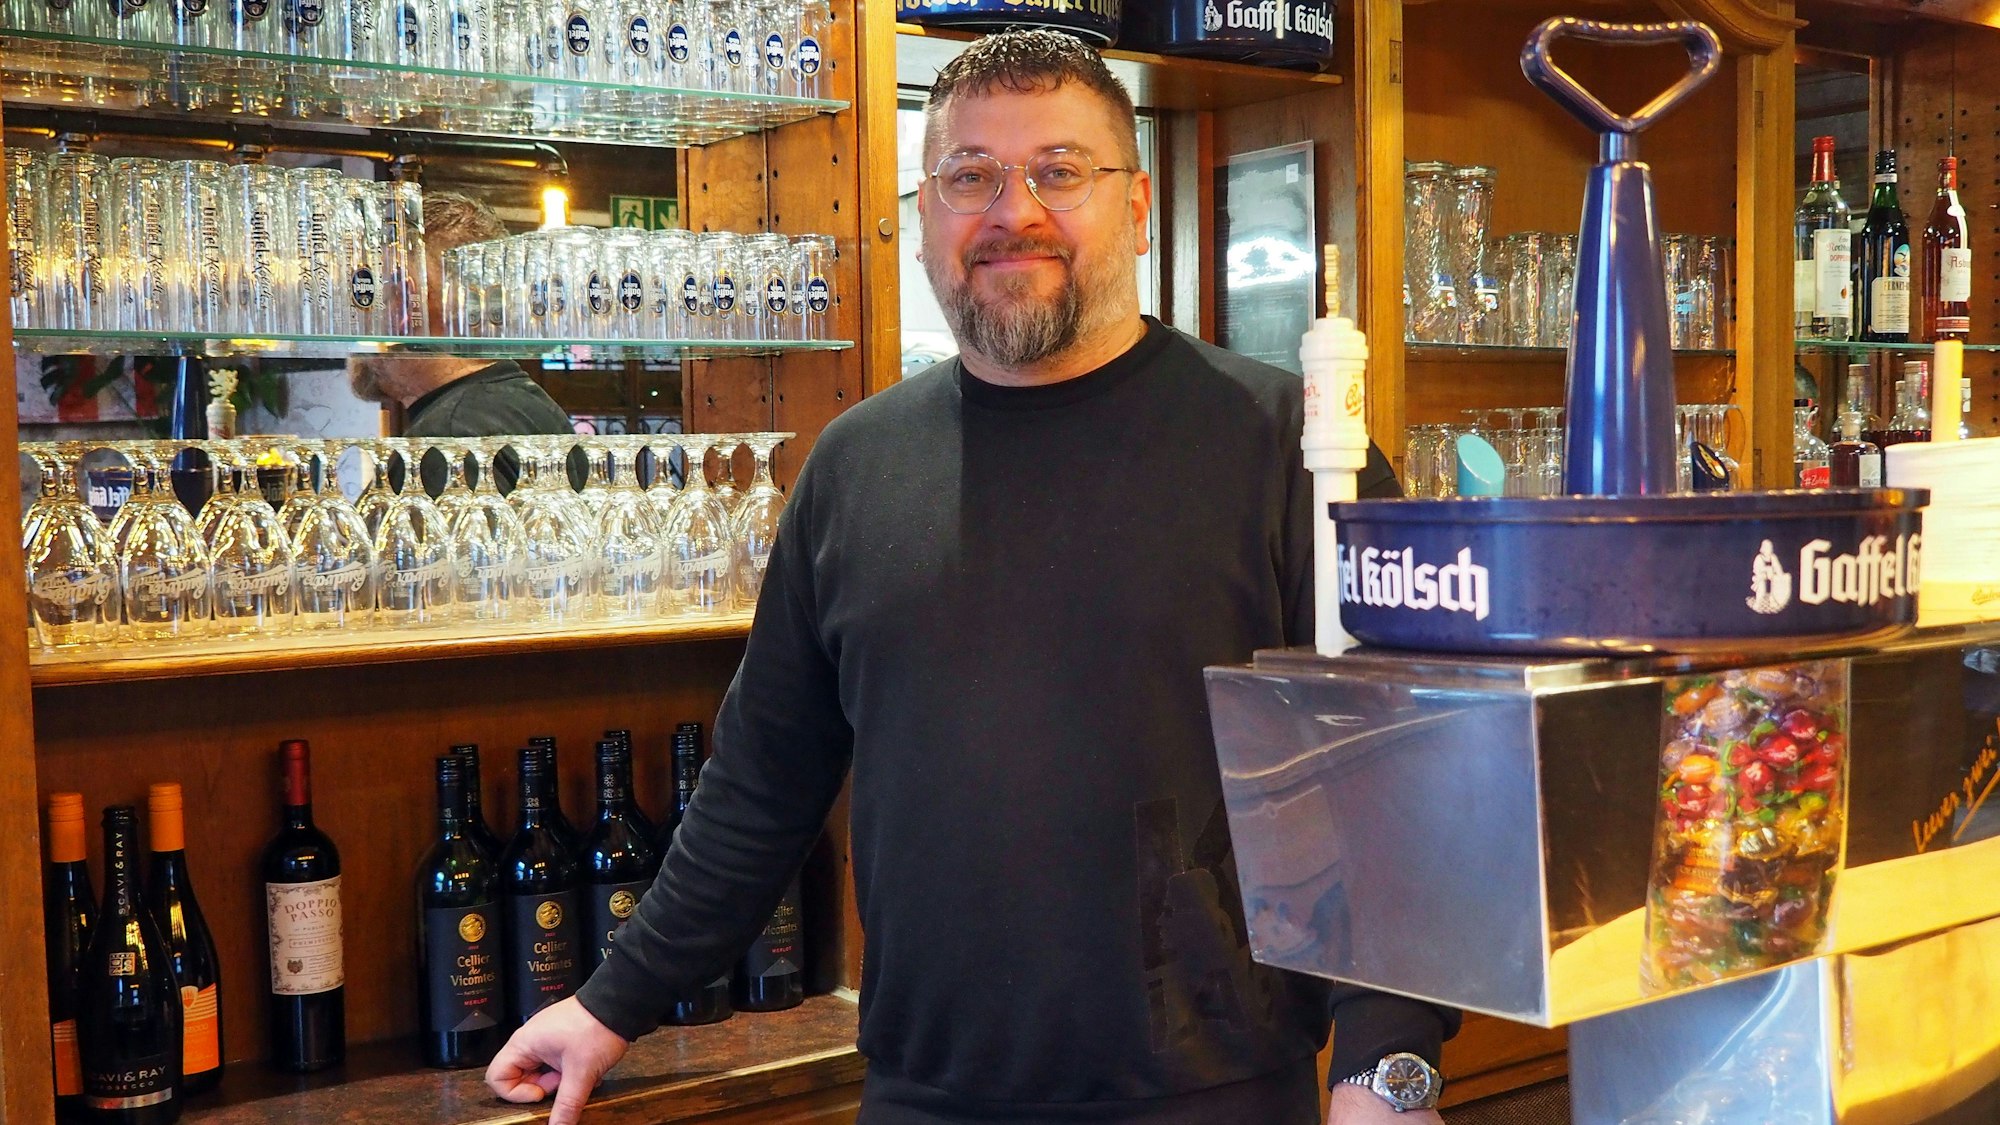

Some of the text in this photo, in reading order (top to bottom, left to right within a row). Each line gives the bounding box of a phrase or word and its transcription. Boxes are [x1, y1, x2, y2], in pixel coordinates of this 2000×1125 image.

[1227, 0, 1292, 32] Gaffel
[203, 207, 219, 249] Gaffel
[310, 213, 329, 255] Gaffel
[714, 289, 734, 299] Gaffel
[808, 290, 828, 301] Gaffel
[307, 565, 367, 592] Budvar
[396, 563, 450, 588] Budvar
[1800, 533, 1905, 608] Gaffel
[1338, 543, 1490, 622] fel Kölsch
[285, 898, 338, 915] DOPPIO
[291, 908, 335, 923] PASSO
[534, 940, 568, 954] Cellier
[456, 954, 491, 968] Cellier
[527, 959, 573, 974] Vicomtes
[450, 971, 496, 987] Vicomtes
[541, 983, 565, 992] MERLOT
[464, 998, 488, 1006] MERLOT
